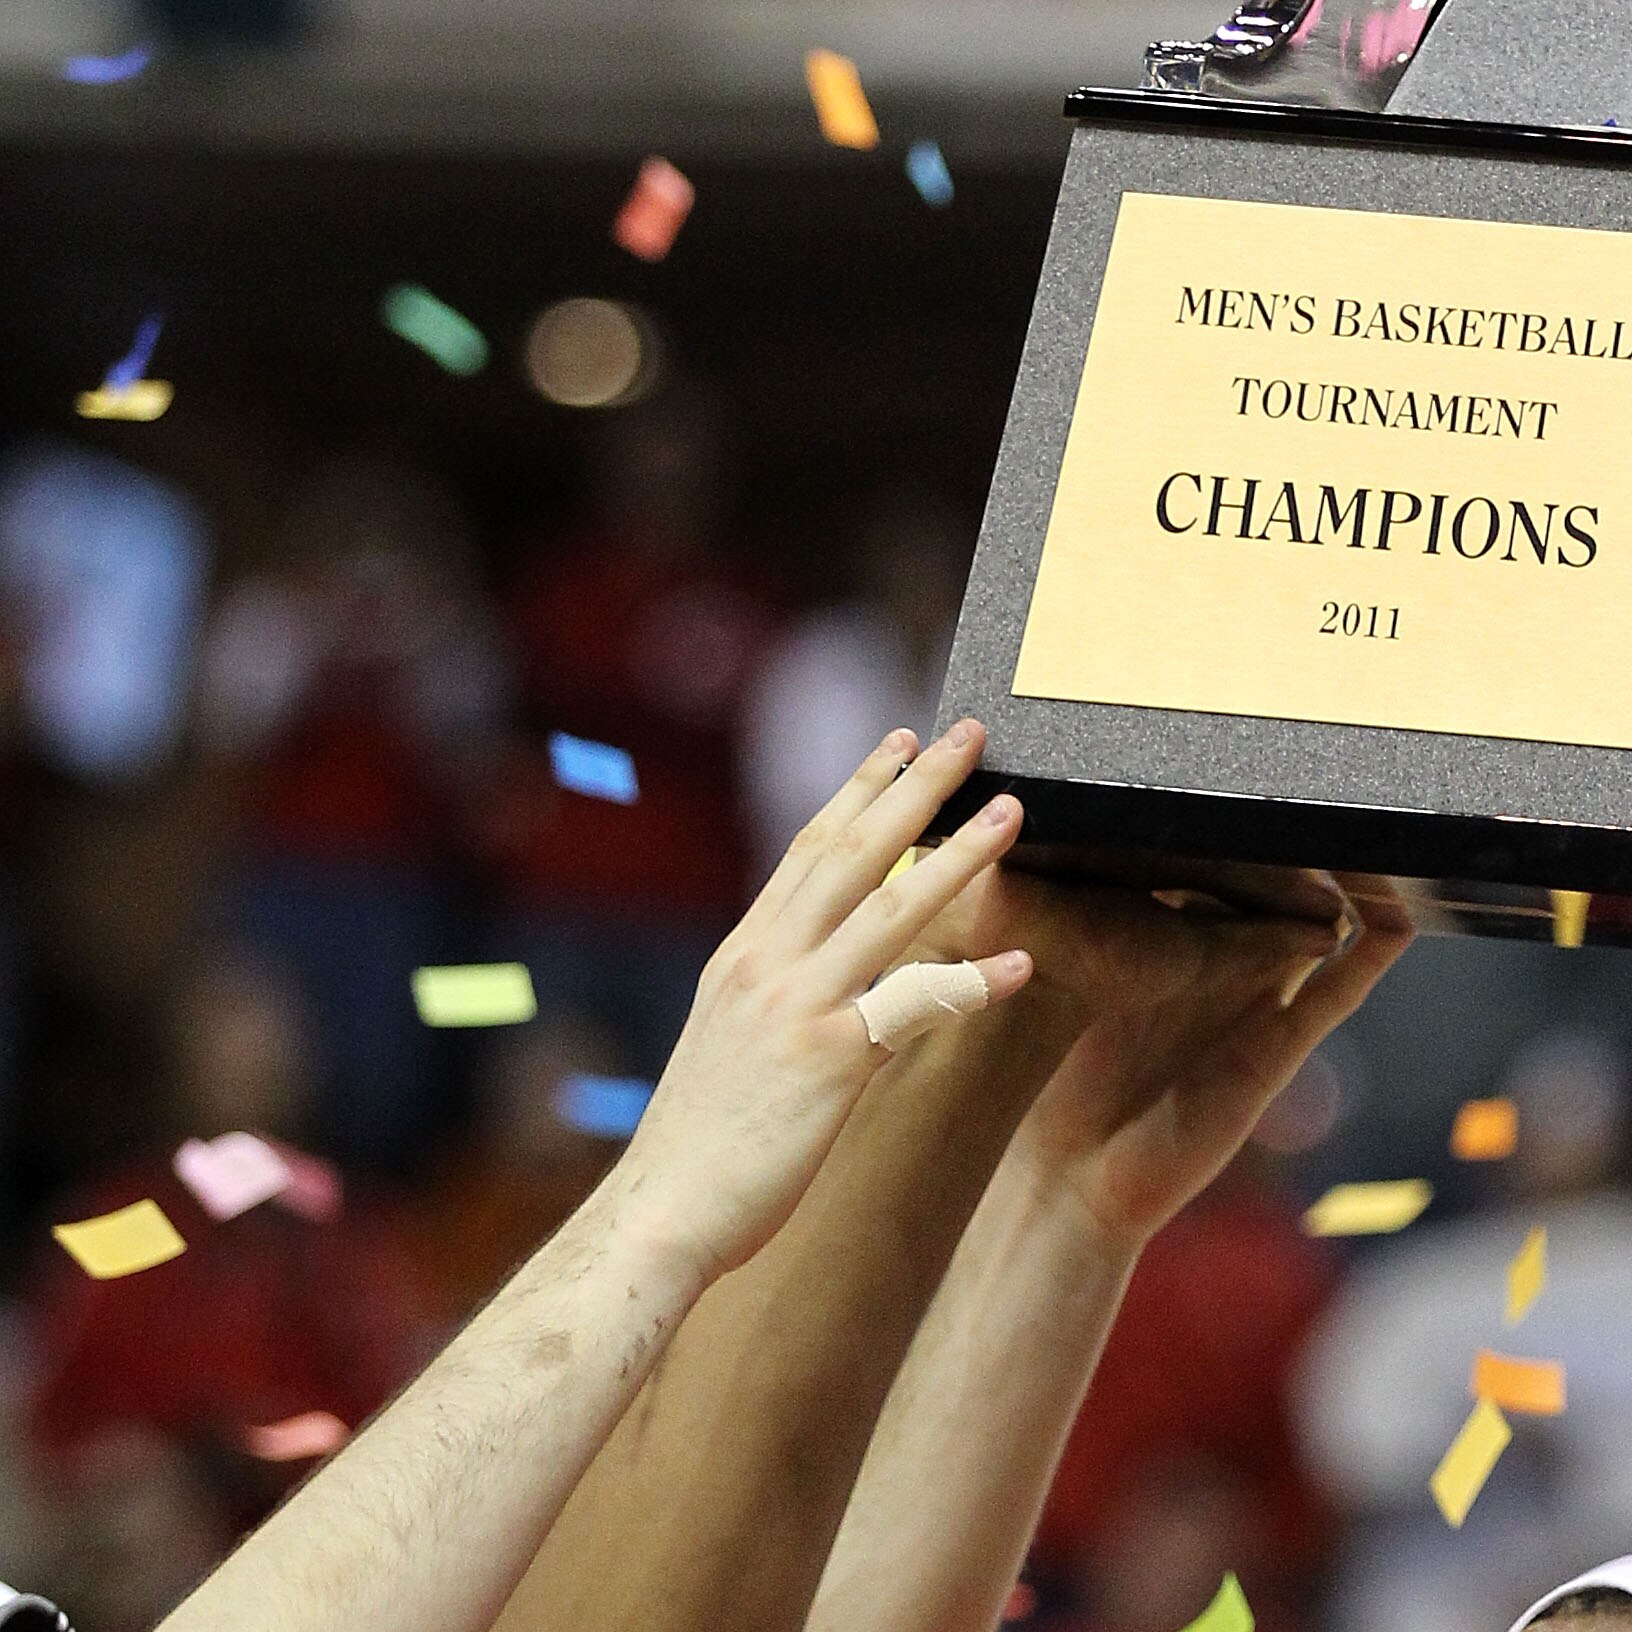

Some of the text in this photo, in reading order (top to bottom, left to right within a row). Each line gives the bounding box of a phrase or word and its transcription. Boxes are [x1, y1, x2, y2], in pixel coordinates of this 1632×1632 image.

[1175, 286, 1316, 334] MEN'S
[1232, 377, 1558, 440] TOURNAMENT
[1156, 472, 1600, 568] CHAMPIONS
[1319, 601, 1402, 640] 2011
